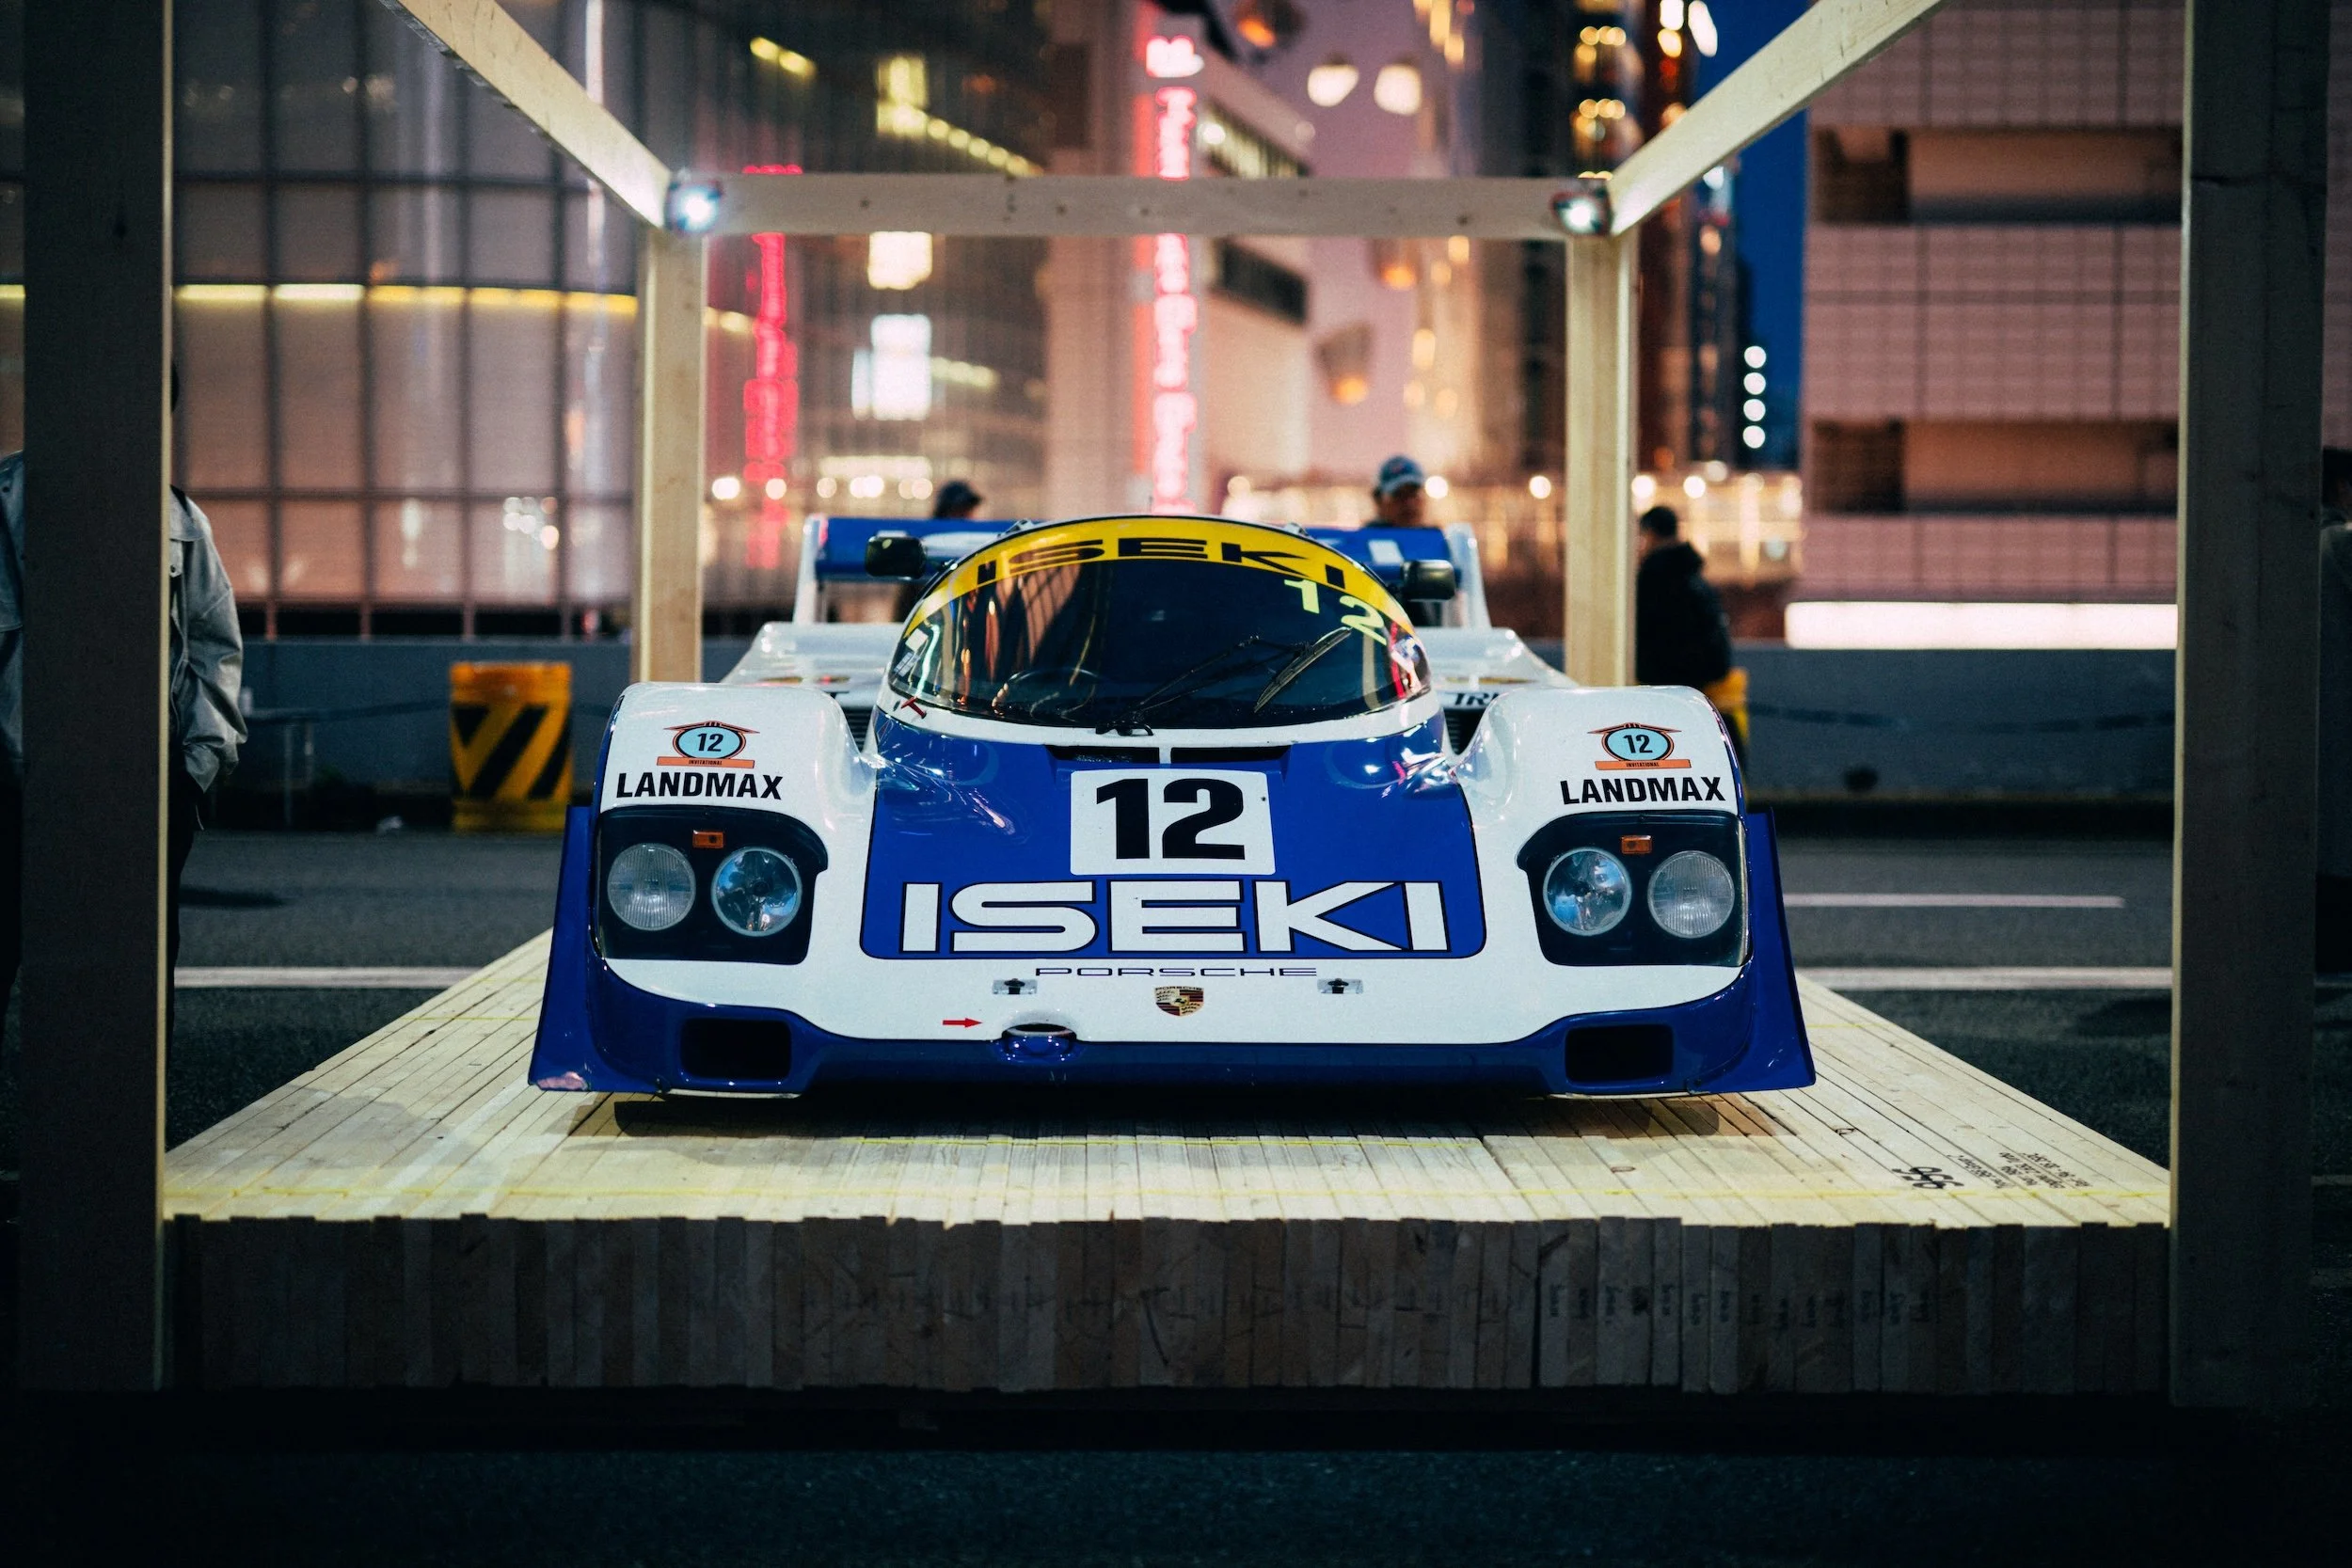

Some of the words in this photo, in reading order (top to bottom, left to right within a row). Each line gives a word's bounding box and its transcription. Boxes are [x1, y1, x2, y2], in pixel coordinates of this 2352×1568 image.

[977, 537, 1345, 590] ISEKI
[1284, 578, 1387, 645] 12
[697, 733, 723, 752] 12
[1623, 734, 1653, 753] 12
[616, 772, 784, 800] LANDMAX
[1560, 777, 1725, 804] LANDMAX
[1096, 778, 1246, 860] 12
[899, 880, 1449, 954] ISEKI
[1036, 967, 1317, 977] PORSCHE
